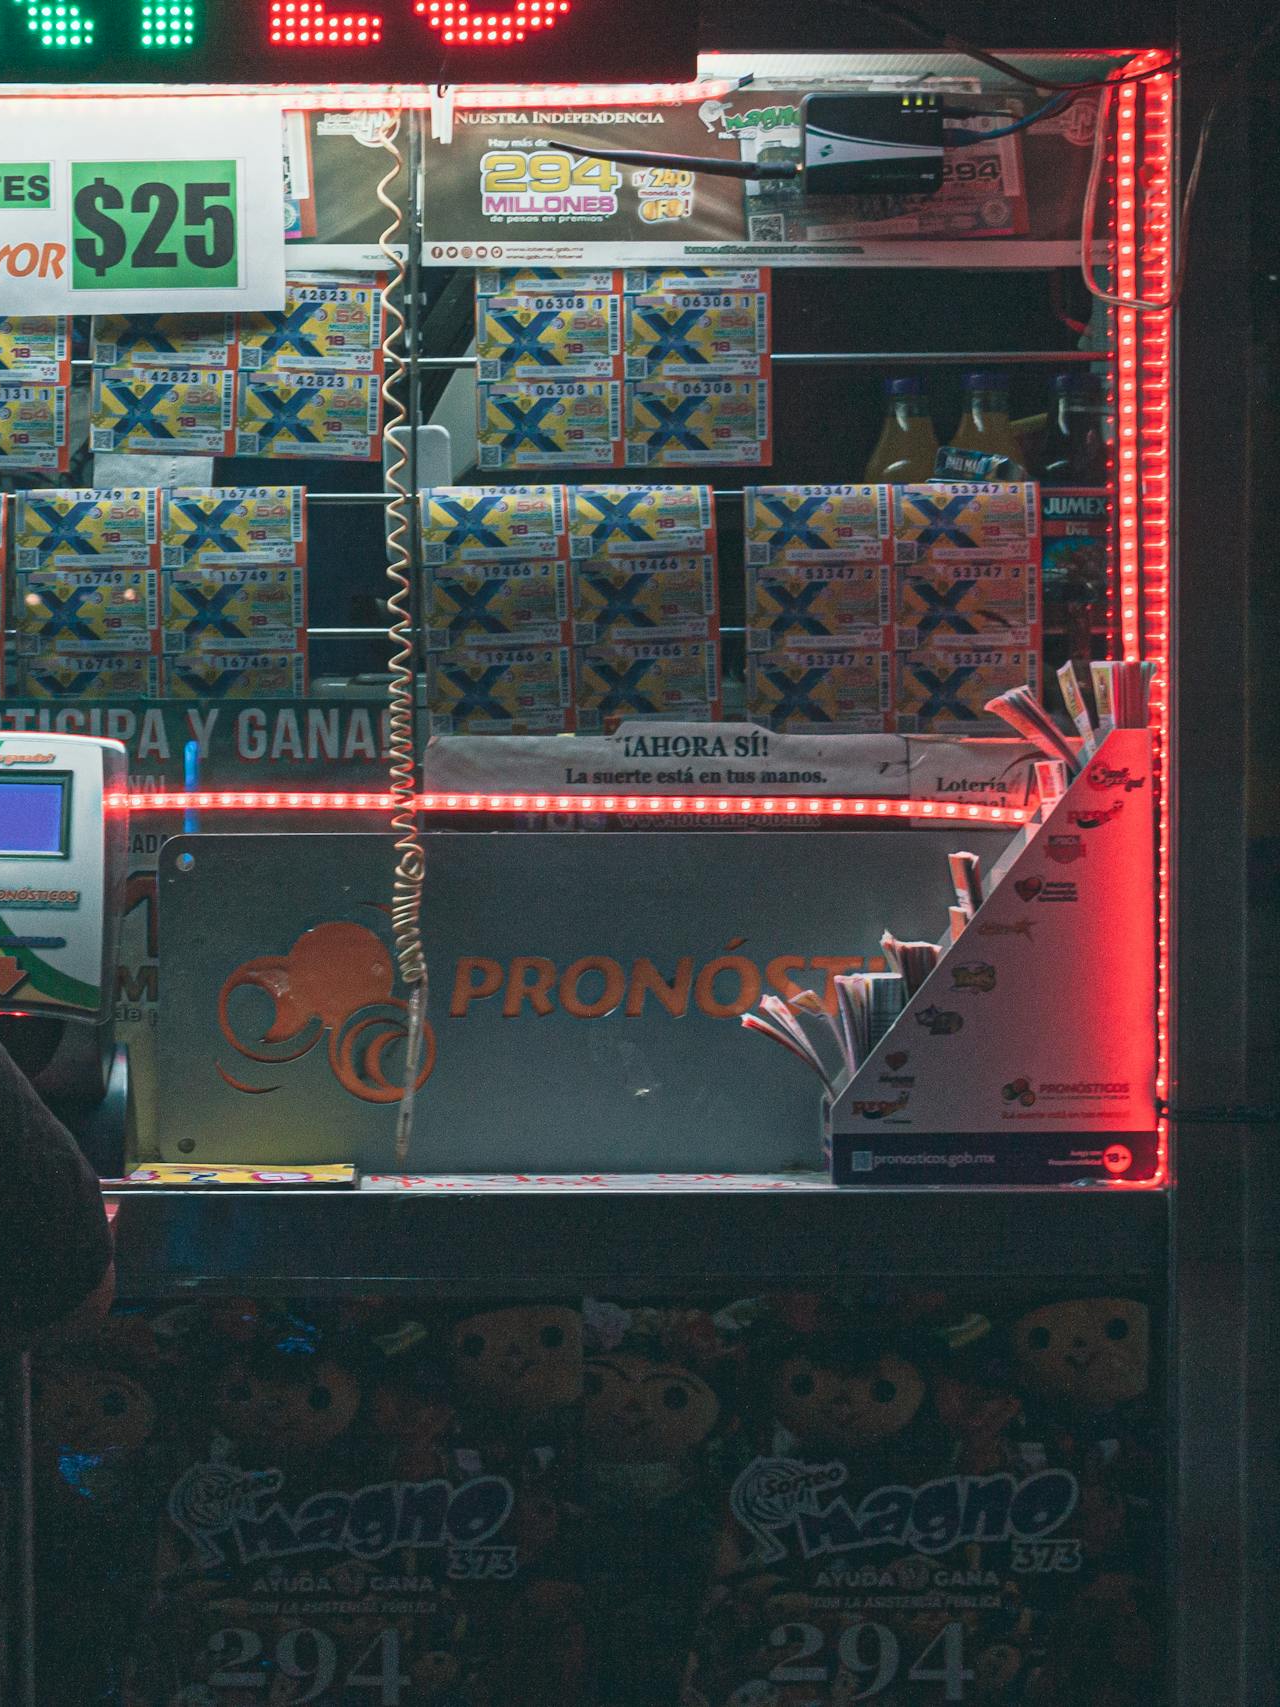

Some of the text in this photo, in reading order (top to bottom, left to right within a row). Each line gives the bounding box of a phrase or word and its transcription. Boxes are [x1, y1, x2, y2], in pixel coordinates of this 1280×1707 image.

[455, 111, 664, 124] NUESTRA INDEPENDENCIA
[484, 155, 619, 193] 294
[485, 196, 614, 213] MILLONES
[73, 177, 236, 277] $25
[299, 290, 348, 301] 42823
[536, 299, 584, 309] 06308
[682, 297, 731, 307] 06308
[151, 372, 199, 383] 42823
[296, 376, 345, 387] 42823
[536, 385, 585, 395] 06308
[682, 384, 732, 394] 06308
[76, 491, 141, 500] 16749 2
[221, 489, 286, 499] 16749 2
[480, 487, 527, 496] 19466
[804, 486, 872, 496] 53347 2
[951, 485, 1018, 495] 53347 2
[1044, 498, 1108, 515] JUMEX
[100, 533, 121, 543] 18
[246, 530, 267, 541] 18
[630, 560, 696, 571] 19466 2
[220, 570, 287, 582] 16749 2
[483, 566, 550, 577] 19466 2
[805, 568, 873, 580] 53347 2
[952, 567, 1002, 579] 53347
[75, 573, 141, 585] 16749 2
[692, 646, 700, 656] 2
[221, 657, 287, 669] 16749 2
[486, 652, 553, 664] 19466 2
[805, 654, 874, 667] 53347 2
[953, 653, 1003, 665] 53347
[77, 659, 142, 670] 16749 2
[624, 731, 769, 758] ¡AHORA SÍ!
[566, 766, 827, 784] La suerte está en tus manos.
[936, 776, 1008, 793] Lotería
[767, 1621, 975, 1700] 294
[206, 1627, 412, 1706] 294
